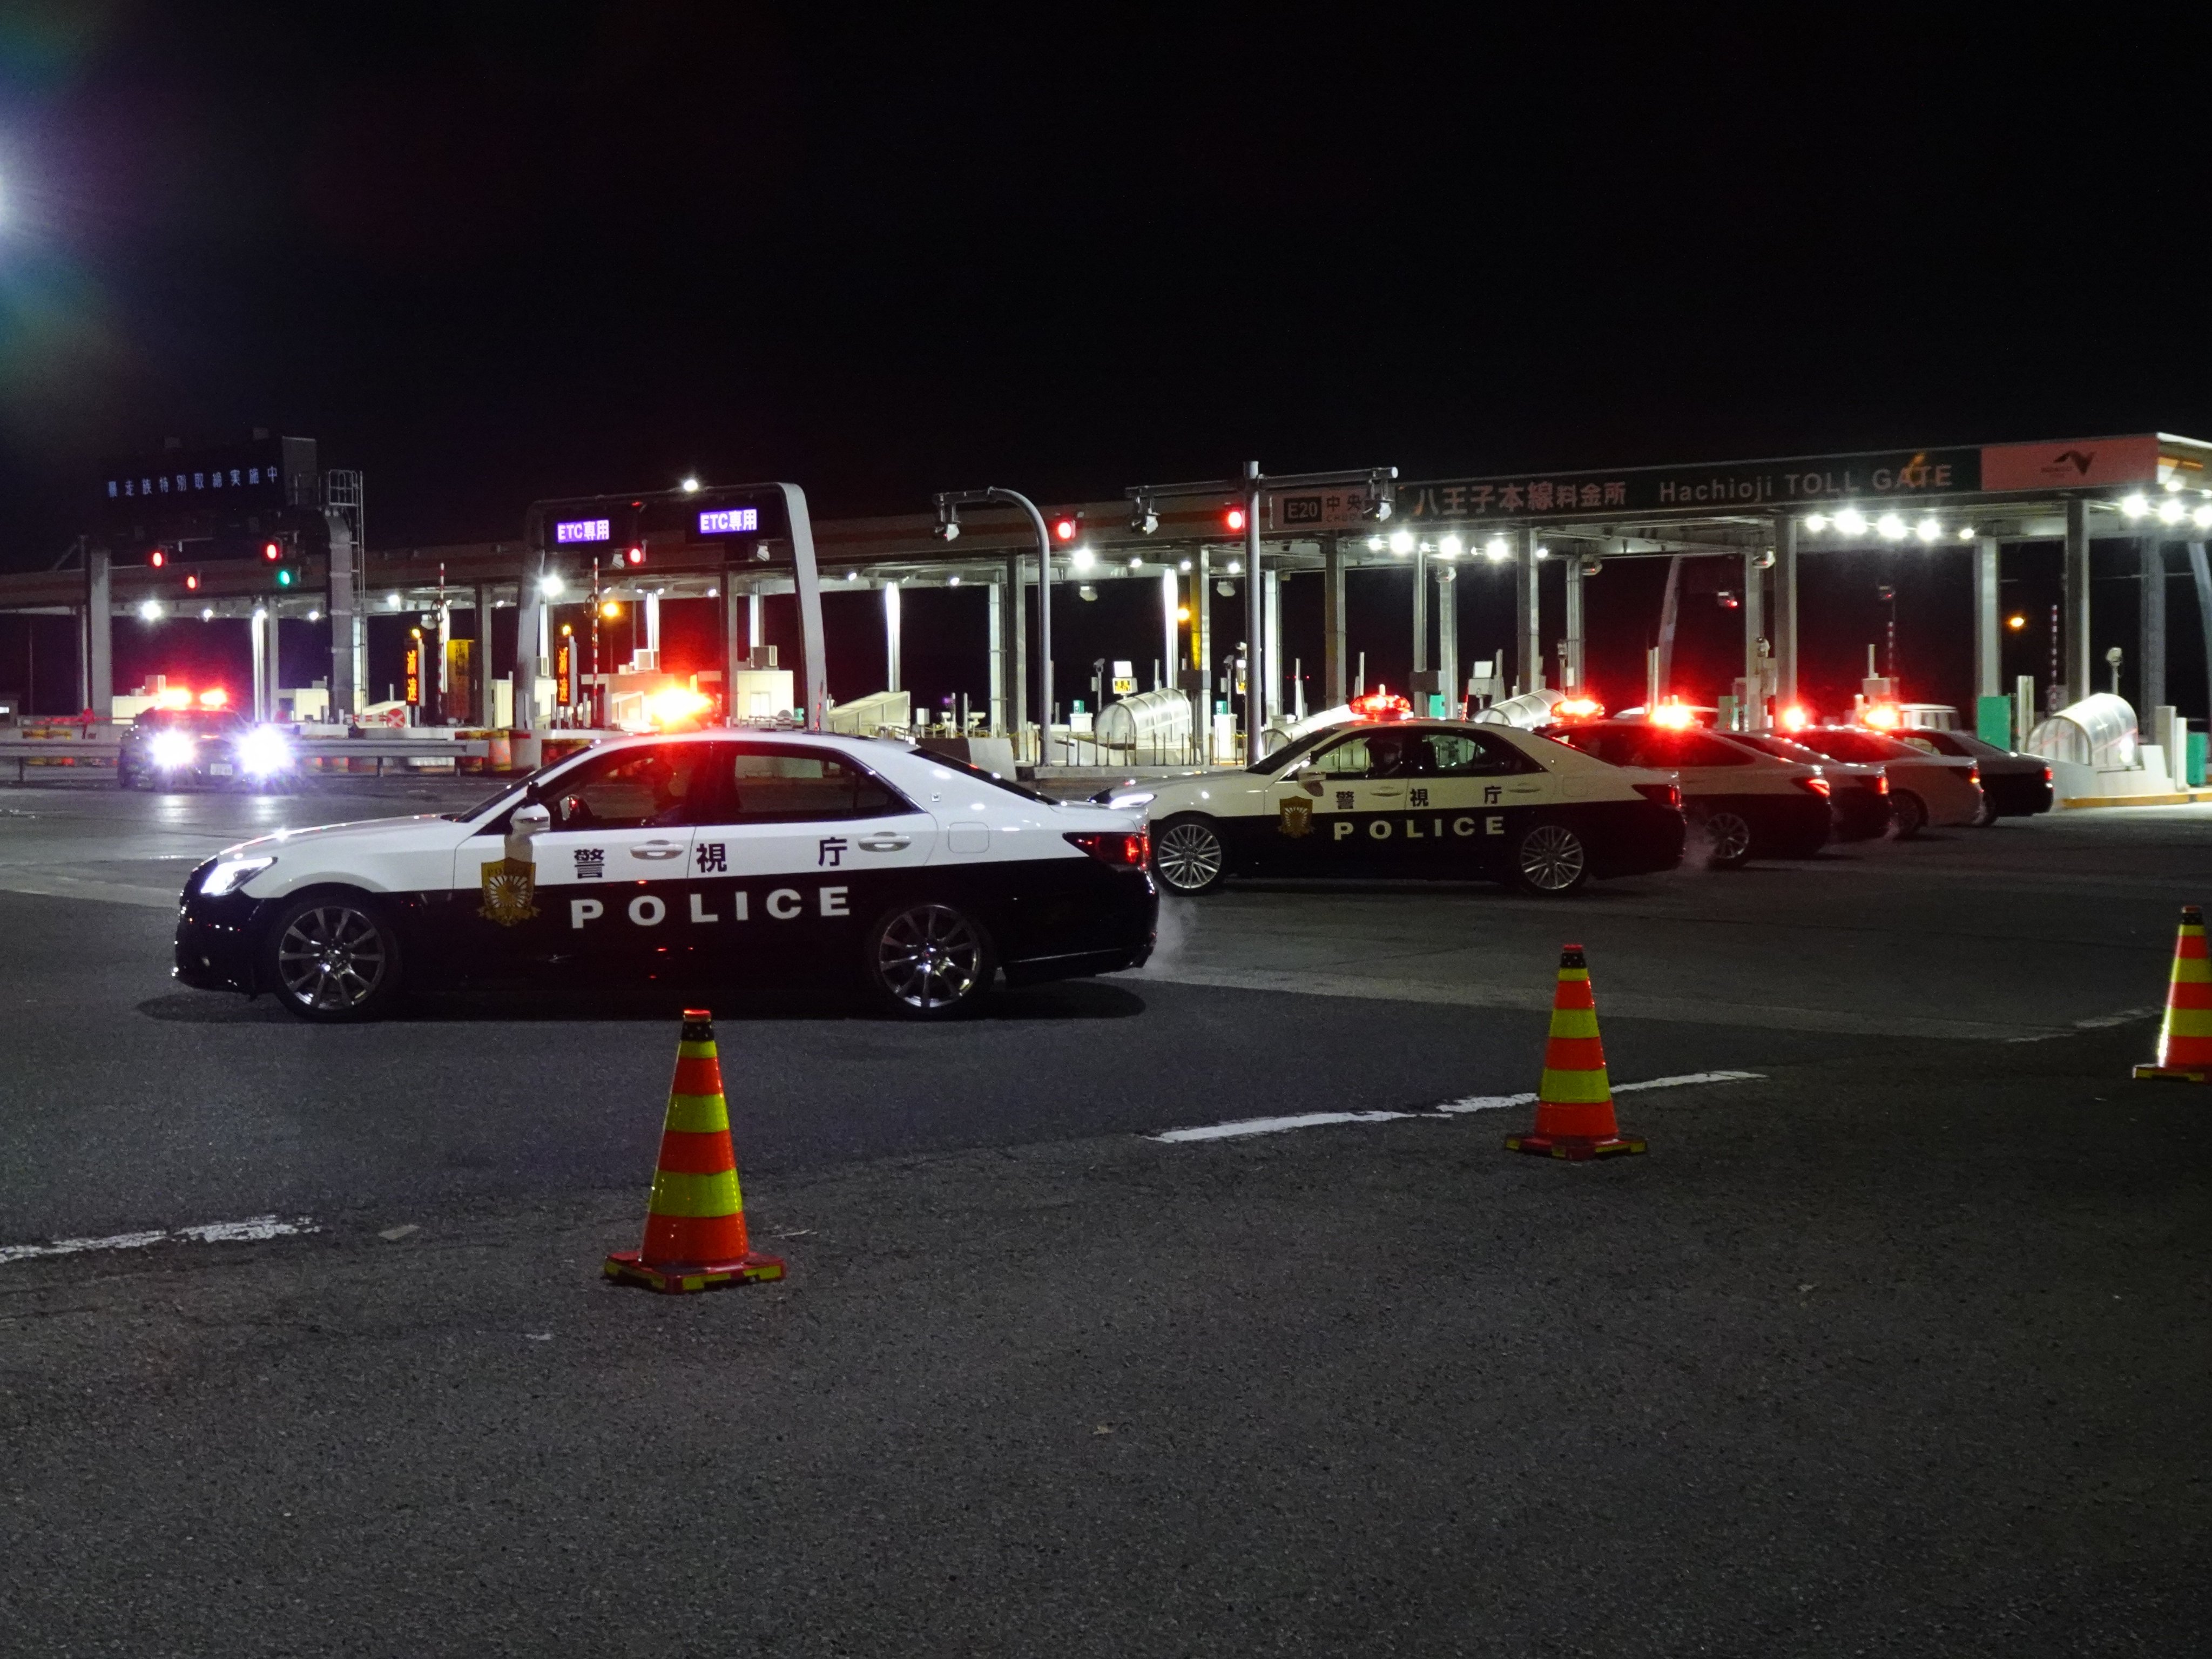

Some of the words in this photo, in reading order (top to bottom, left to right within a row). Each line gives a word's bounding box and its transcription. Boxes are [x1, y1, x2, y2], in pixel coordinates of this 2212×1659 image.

[1660, 476, 1772, 503] Hachioji
[1785, 470, 1859, 495] TOLL
[1872, 464, 1953, 491] GATE
[1288, 501, 1318, 519] E20
[1412, 481, 1626, 516] 八王子本線料金所
[558, 520, 609, 541] ETC専用
[701, 509, 757, 531] ETC専用
[1336, 786, 1502, 810] 警視庁
[1333, 816, 1505, 840] POLICE
[574, 837, 848, 879] 警視庁
[571, 886, 849, 929] POLICE
